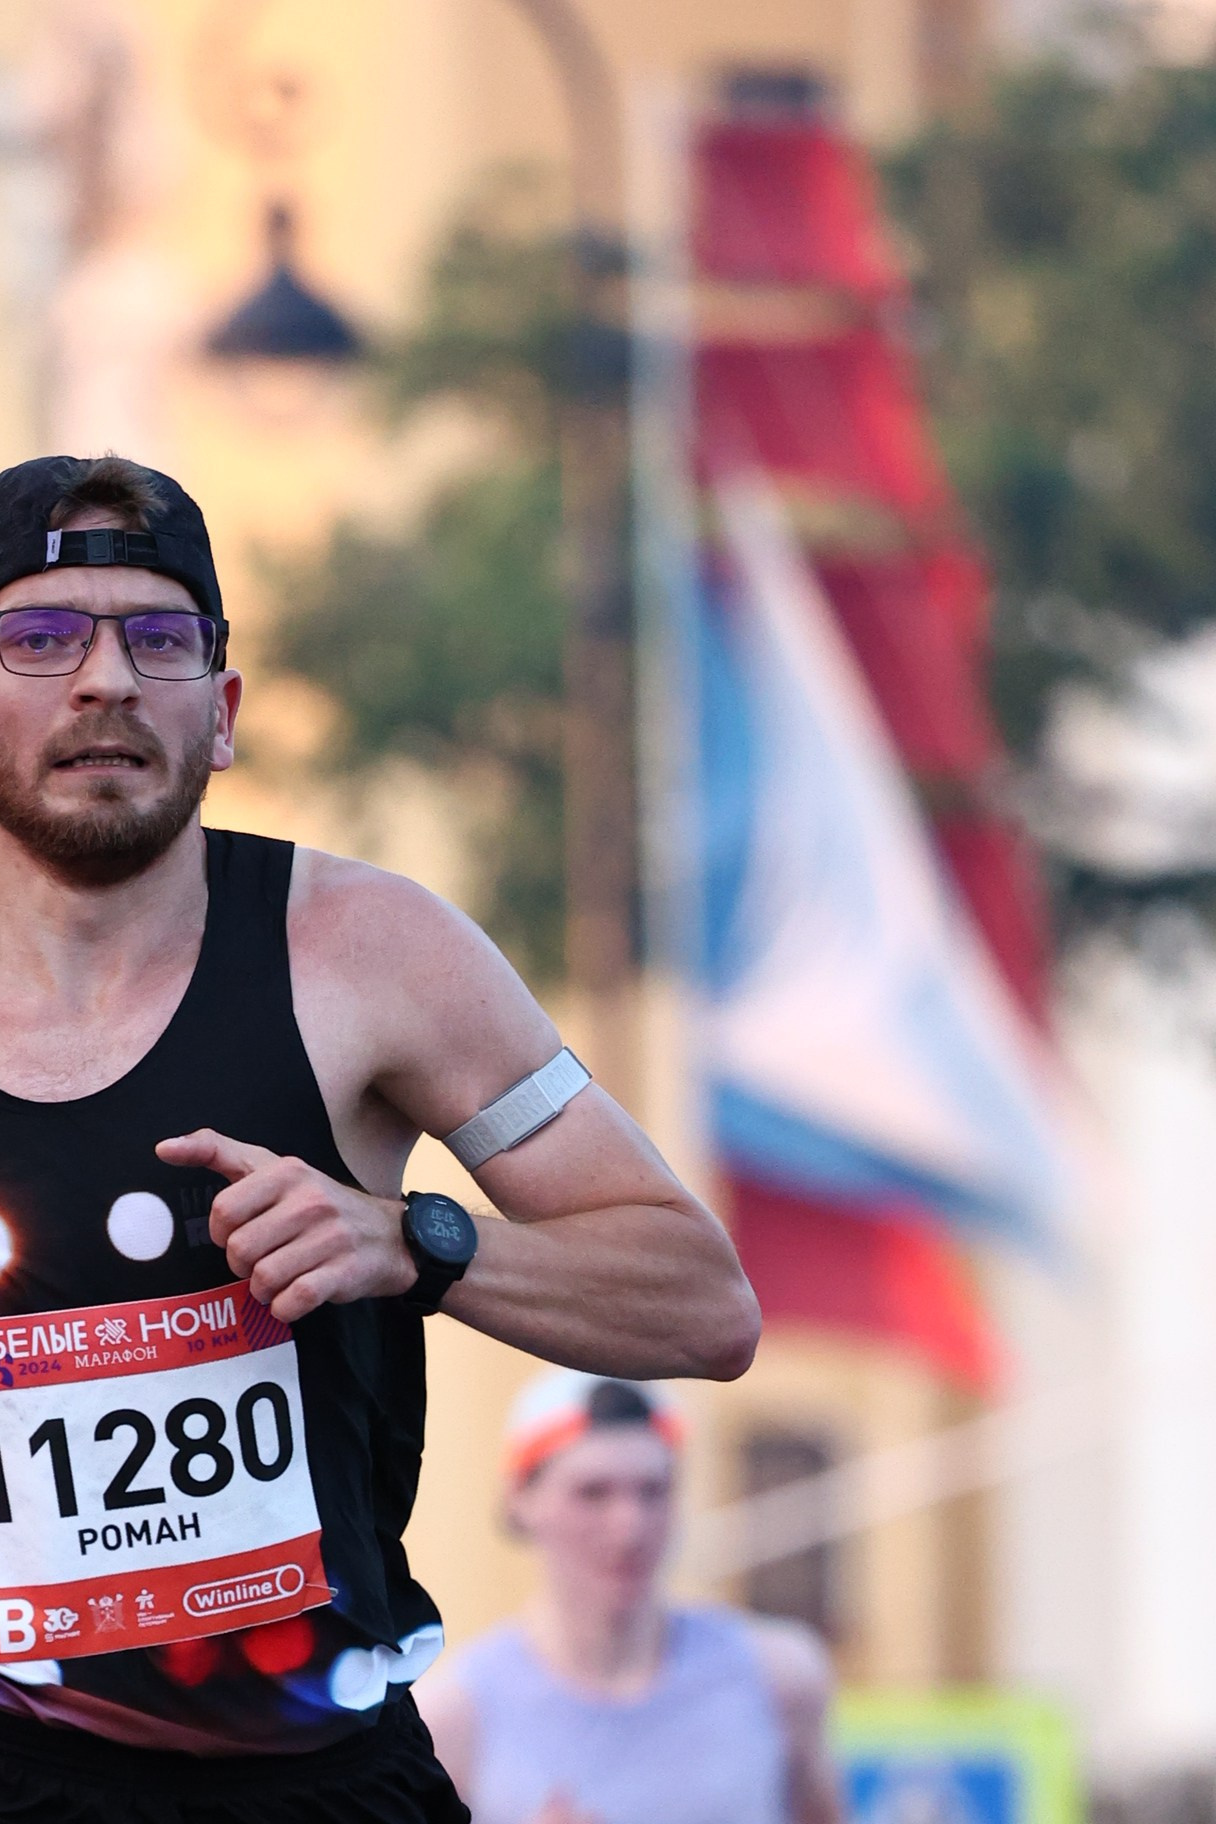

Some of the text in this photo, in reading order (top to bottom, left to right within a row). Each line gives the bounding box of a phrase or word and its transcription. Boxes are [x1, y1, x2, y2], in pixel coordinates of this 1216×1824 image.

[139, 1296, 236, 1343] НОЧИ
[74, 1346, 158, 1369] МАРАФОН
[187, 1340, 205, 1353] 10
[19, 1360, 62, 1376] 2024
[78, 1512, 202, 1556] РОМАН
[194, 1581, 274, 1609] Winline
